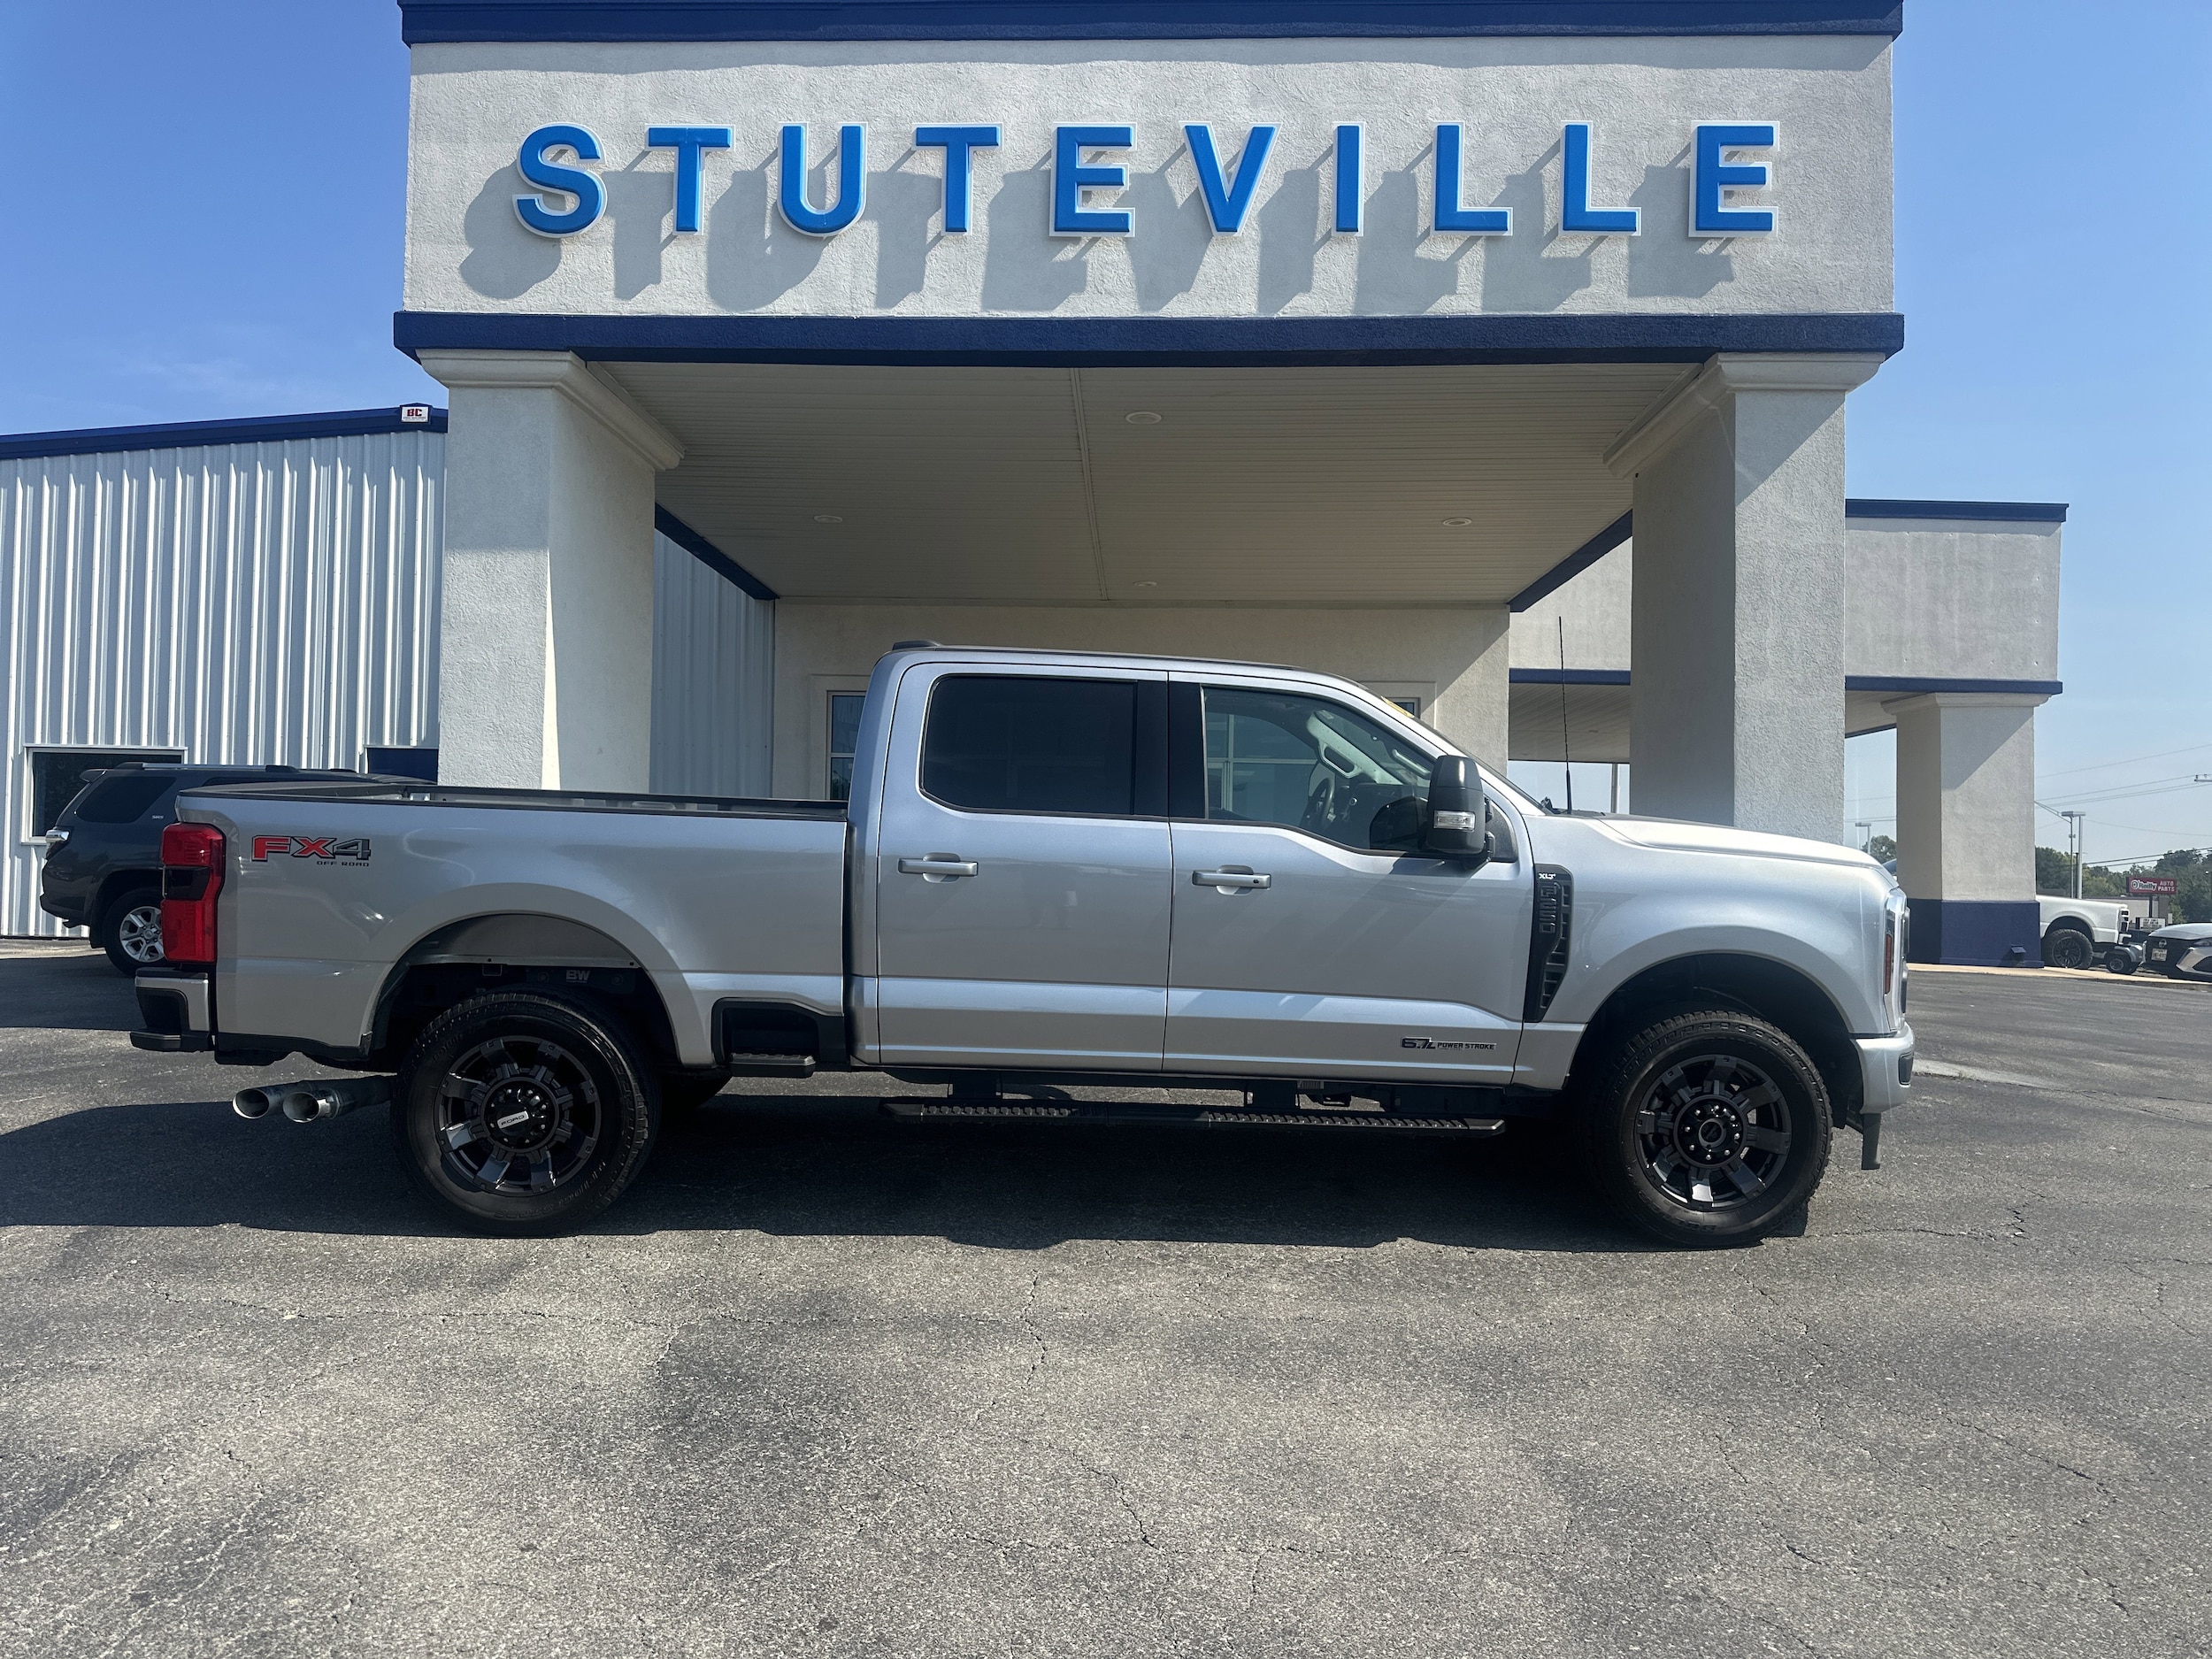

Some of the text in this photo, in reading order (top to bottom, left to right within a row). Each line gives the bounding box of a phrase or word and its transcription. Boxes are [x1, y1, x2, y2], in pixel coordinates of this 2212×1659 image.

[511, 119, 1780, 238] STUTEVILLE
[252, 834, 372, 863] FX4
[1538, 872, 1556, 880] XLT
